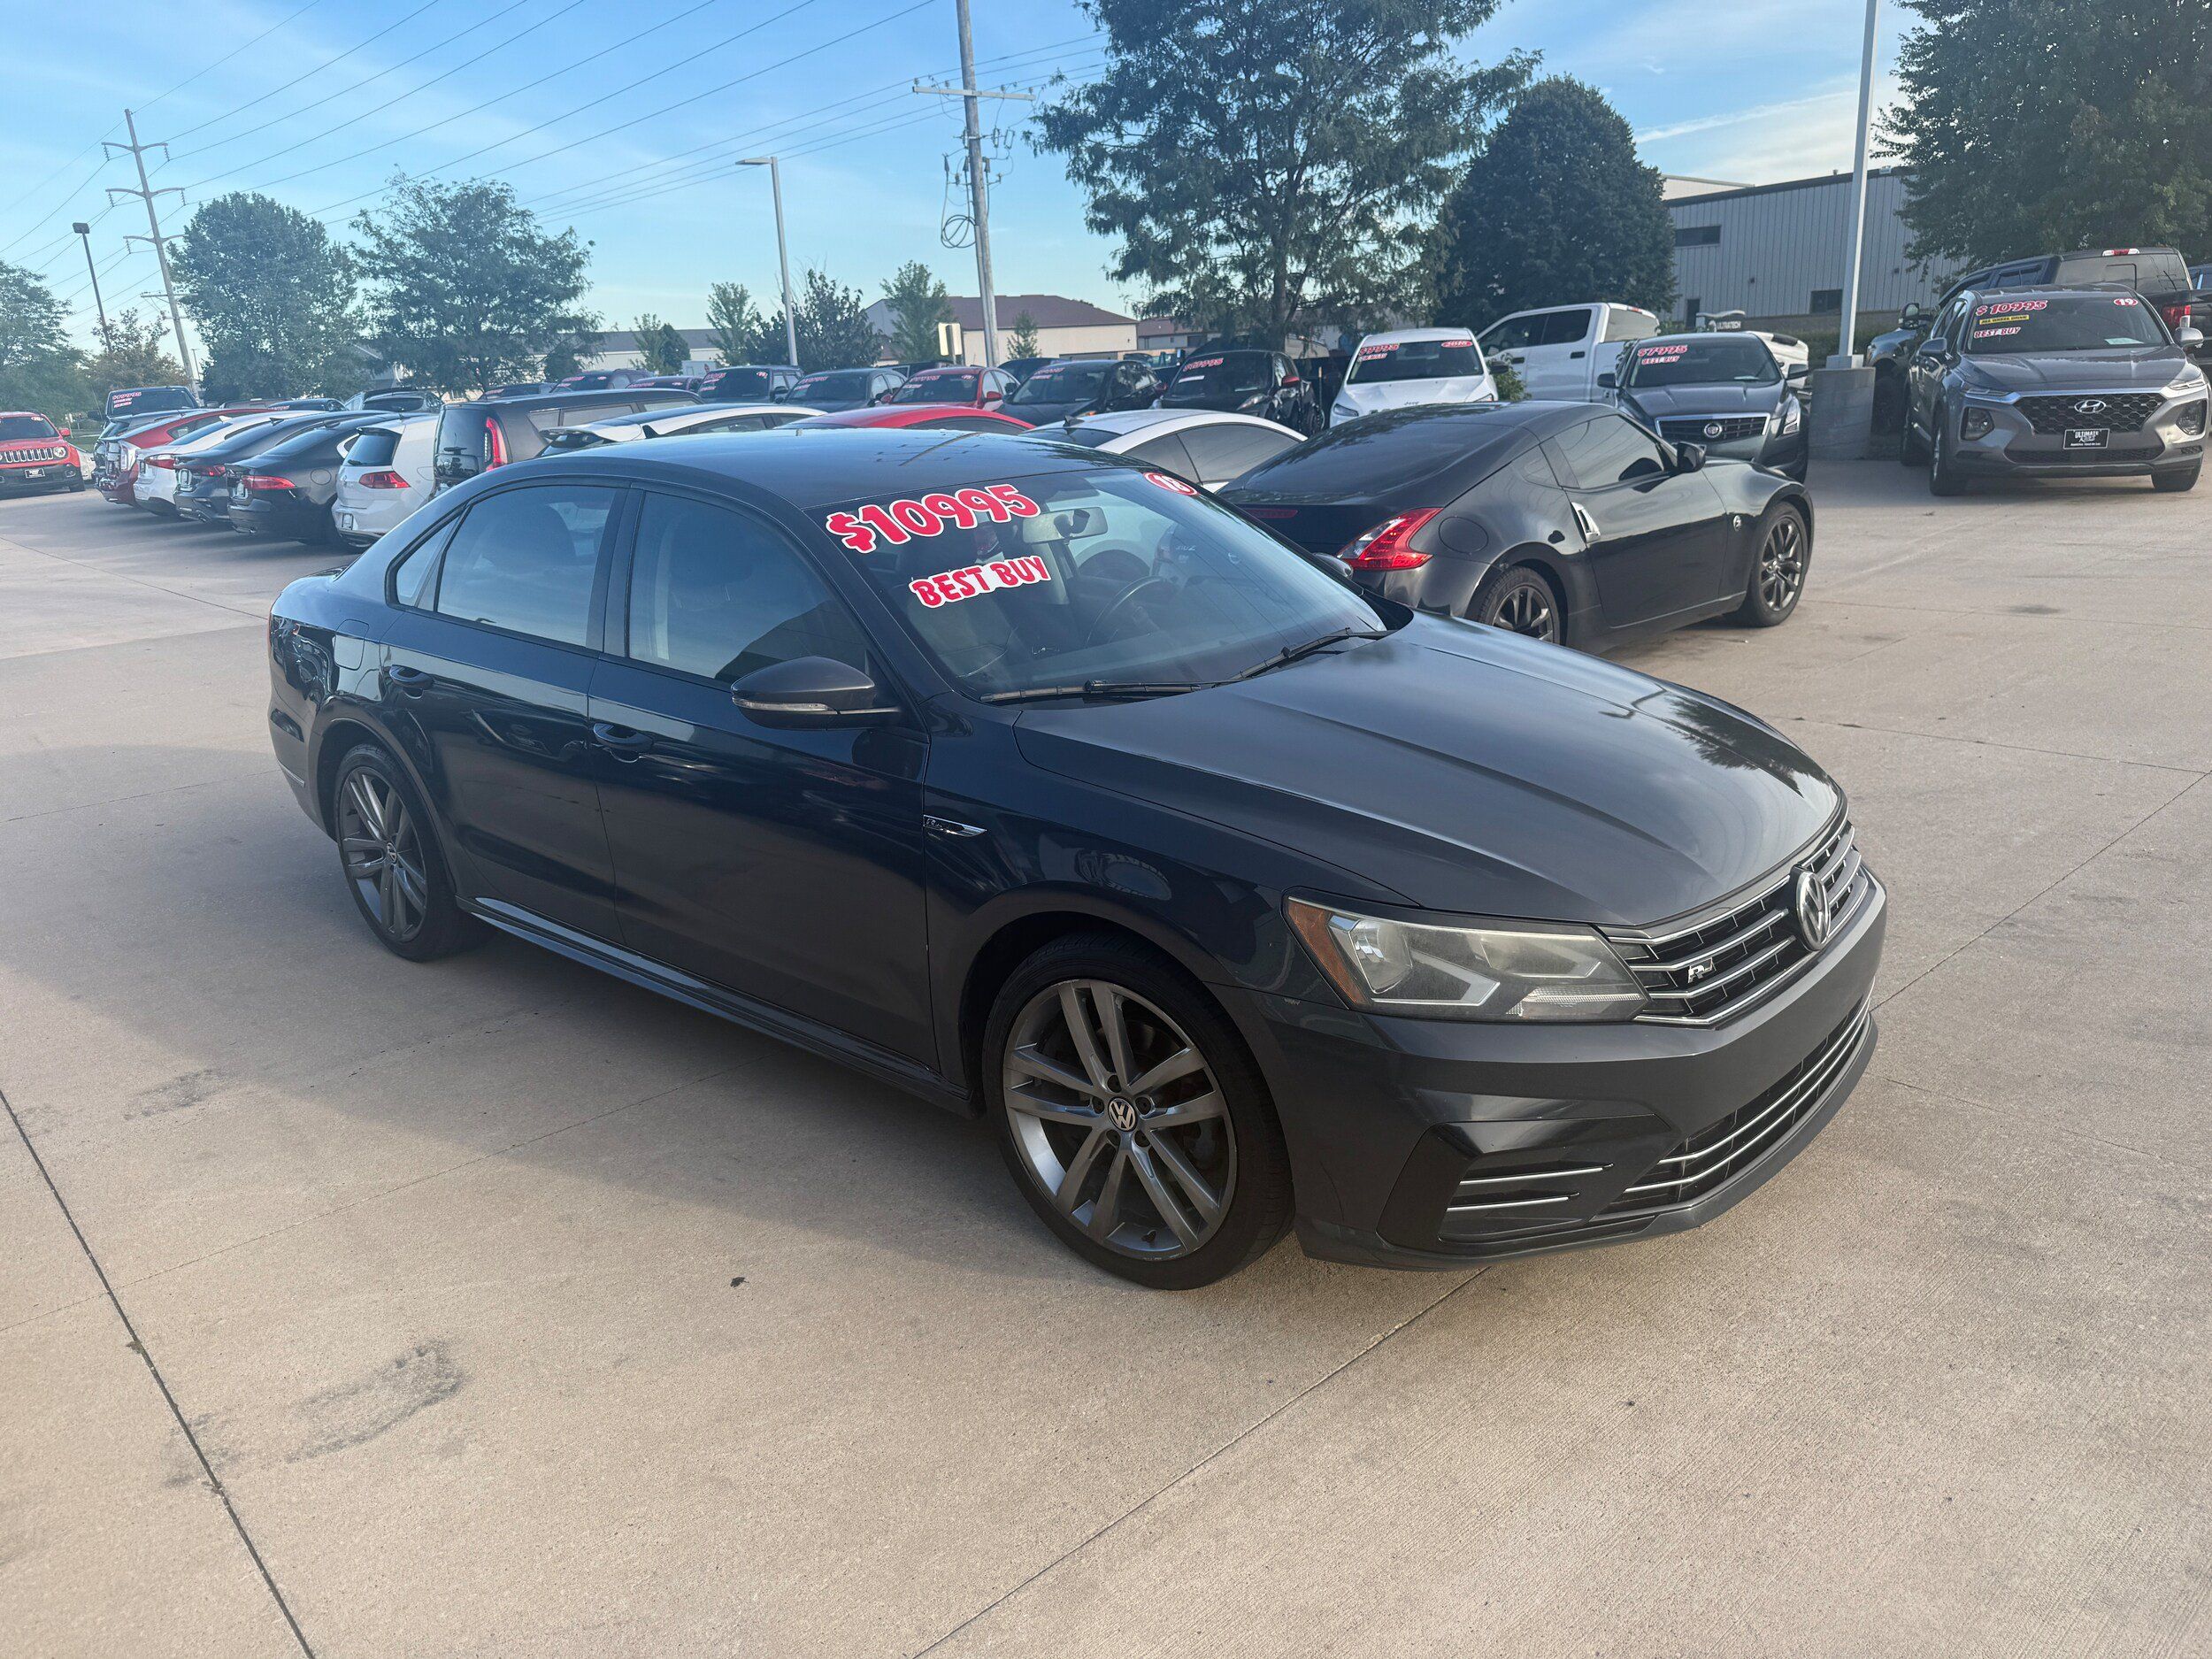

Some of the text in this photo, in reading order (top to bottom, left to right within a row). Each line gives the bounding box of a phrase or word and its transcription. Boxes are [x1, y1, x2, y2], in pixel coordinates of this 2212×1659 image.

[826, 484, 1041, 553] $10995
[910, 556, 1051, 608] BEST BUY
